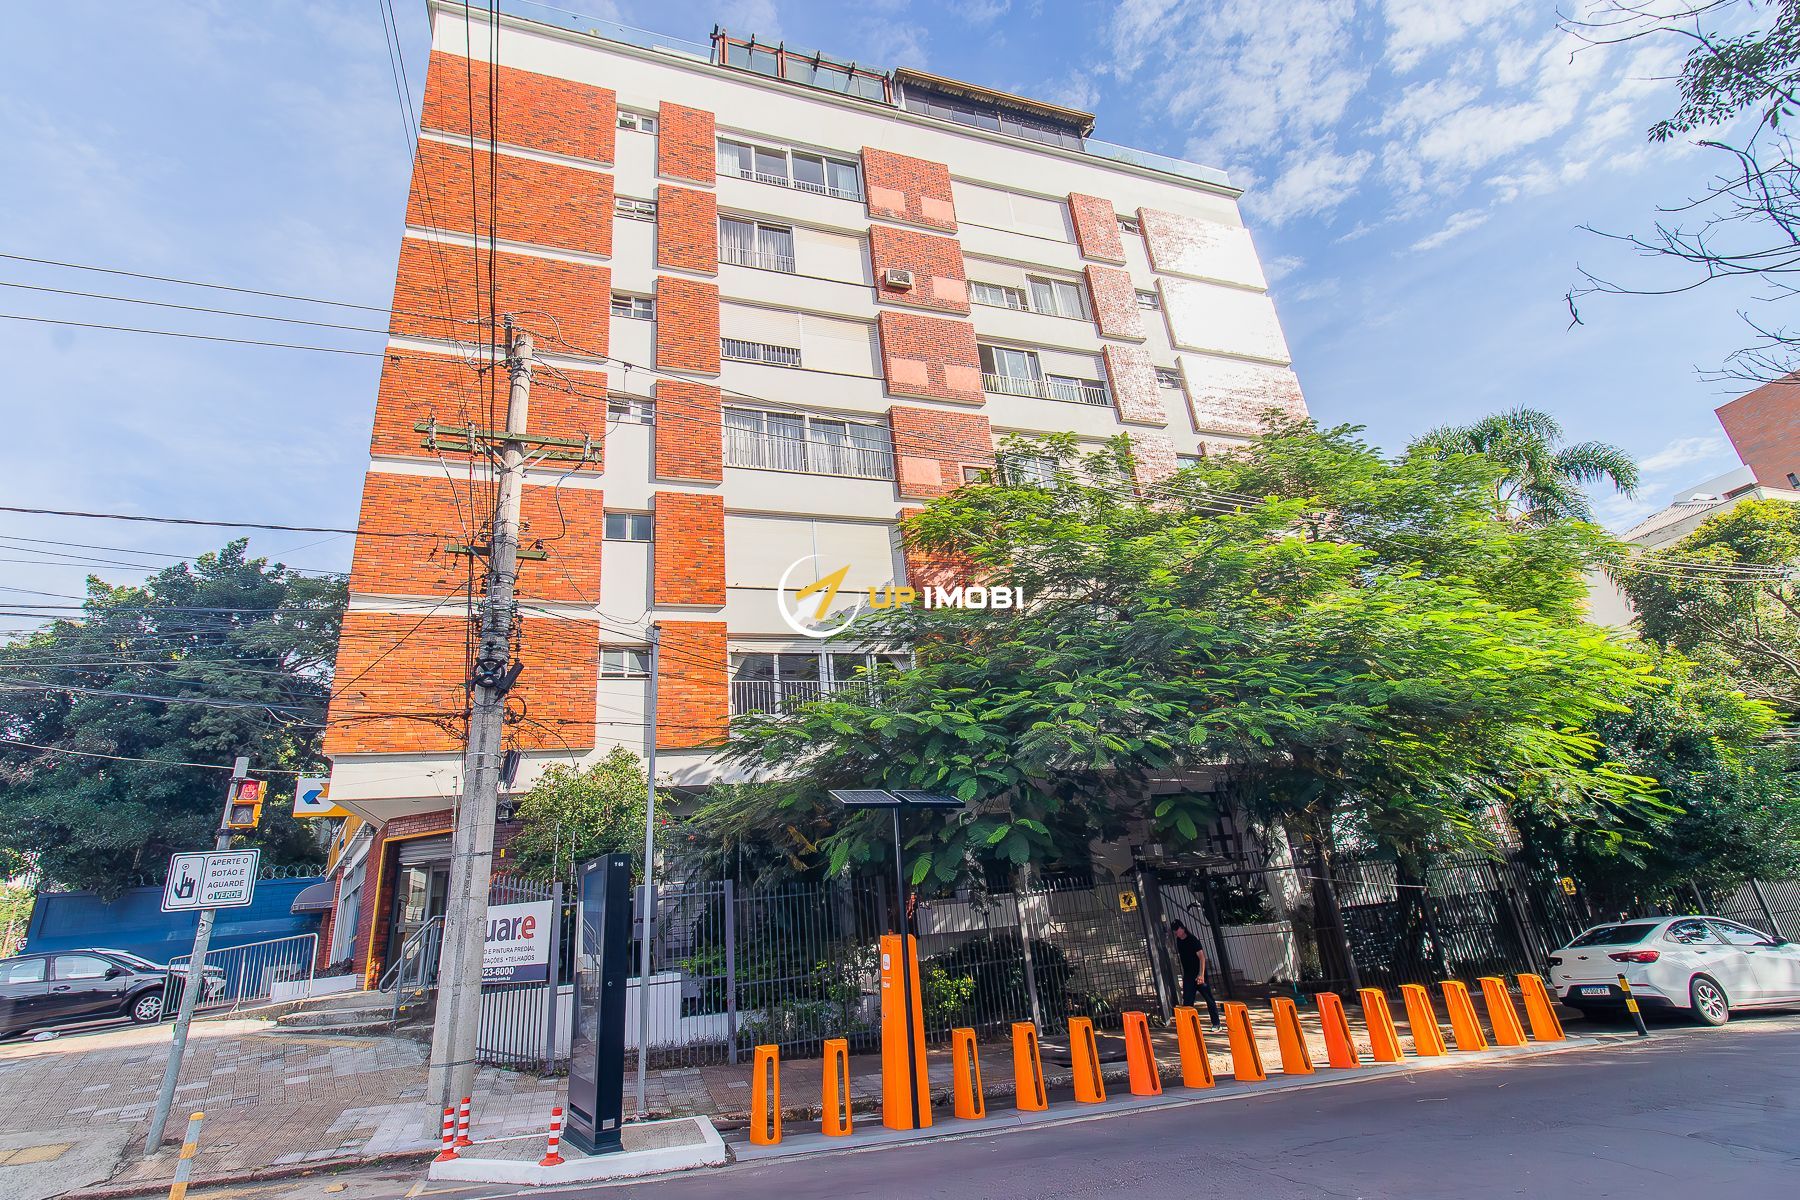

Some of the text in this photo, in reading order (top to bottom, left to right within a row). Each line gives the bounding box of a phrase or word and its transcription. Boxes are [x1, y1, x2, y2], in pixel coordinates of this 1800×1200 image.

[211, 858, 241, 866] APERTE
[211, 868, 238, 877] BOTÃO
[207, 880, 245, 889] AGUARDE
[214, 890, 242, 899] VERDE
[492, 947, 514, 955] PINTURA
[514, 945, 535, 953] PREDIAL
